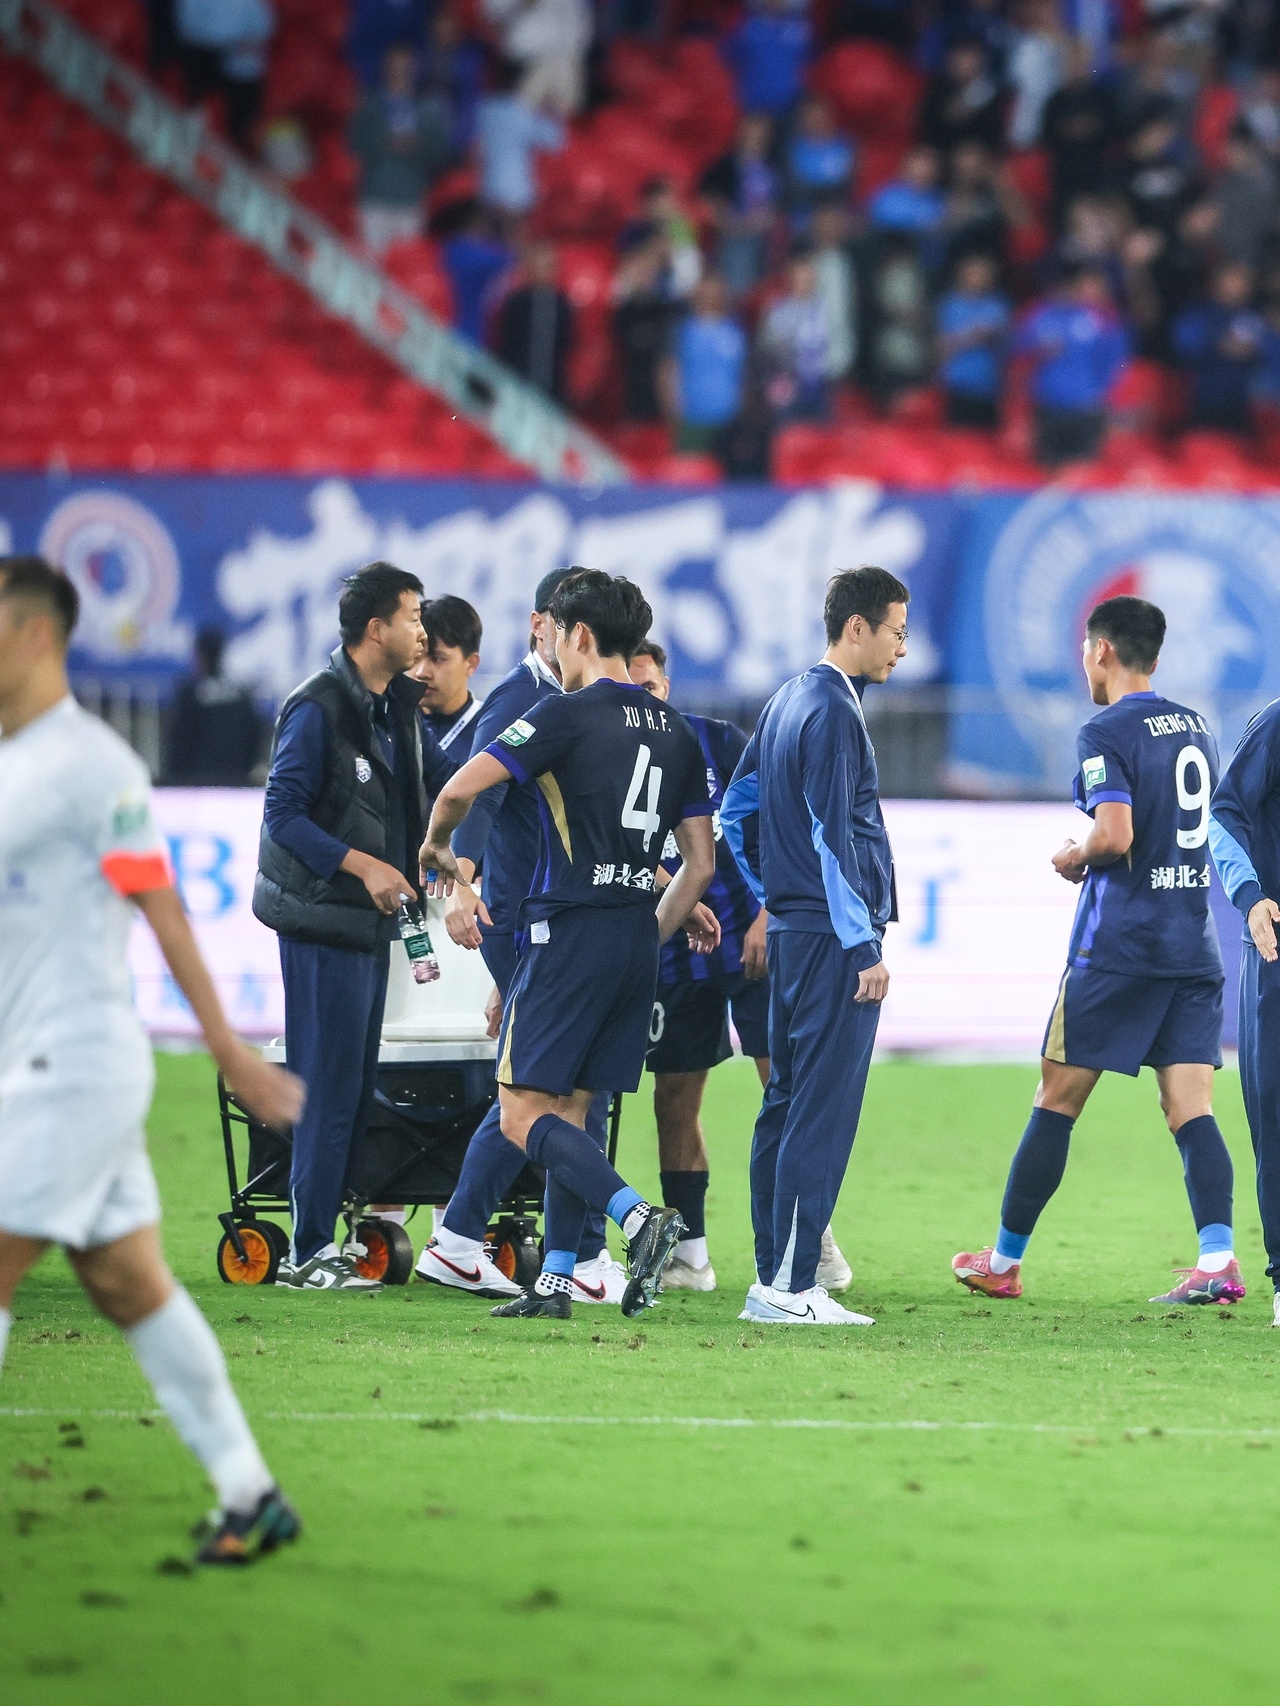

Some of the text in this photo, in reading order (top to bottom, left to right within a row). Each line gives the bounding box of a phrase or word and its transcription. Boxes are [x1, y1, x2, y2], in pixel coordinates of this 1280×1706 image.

[622, 705, 641, 728] XU
[1143, 712, 1187, 738] ZHENG
[621, 743, 663, 853] 4
[1175, 744, 1211, 850] 9
[592, 863, 657, 892] 湖北金
